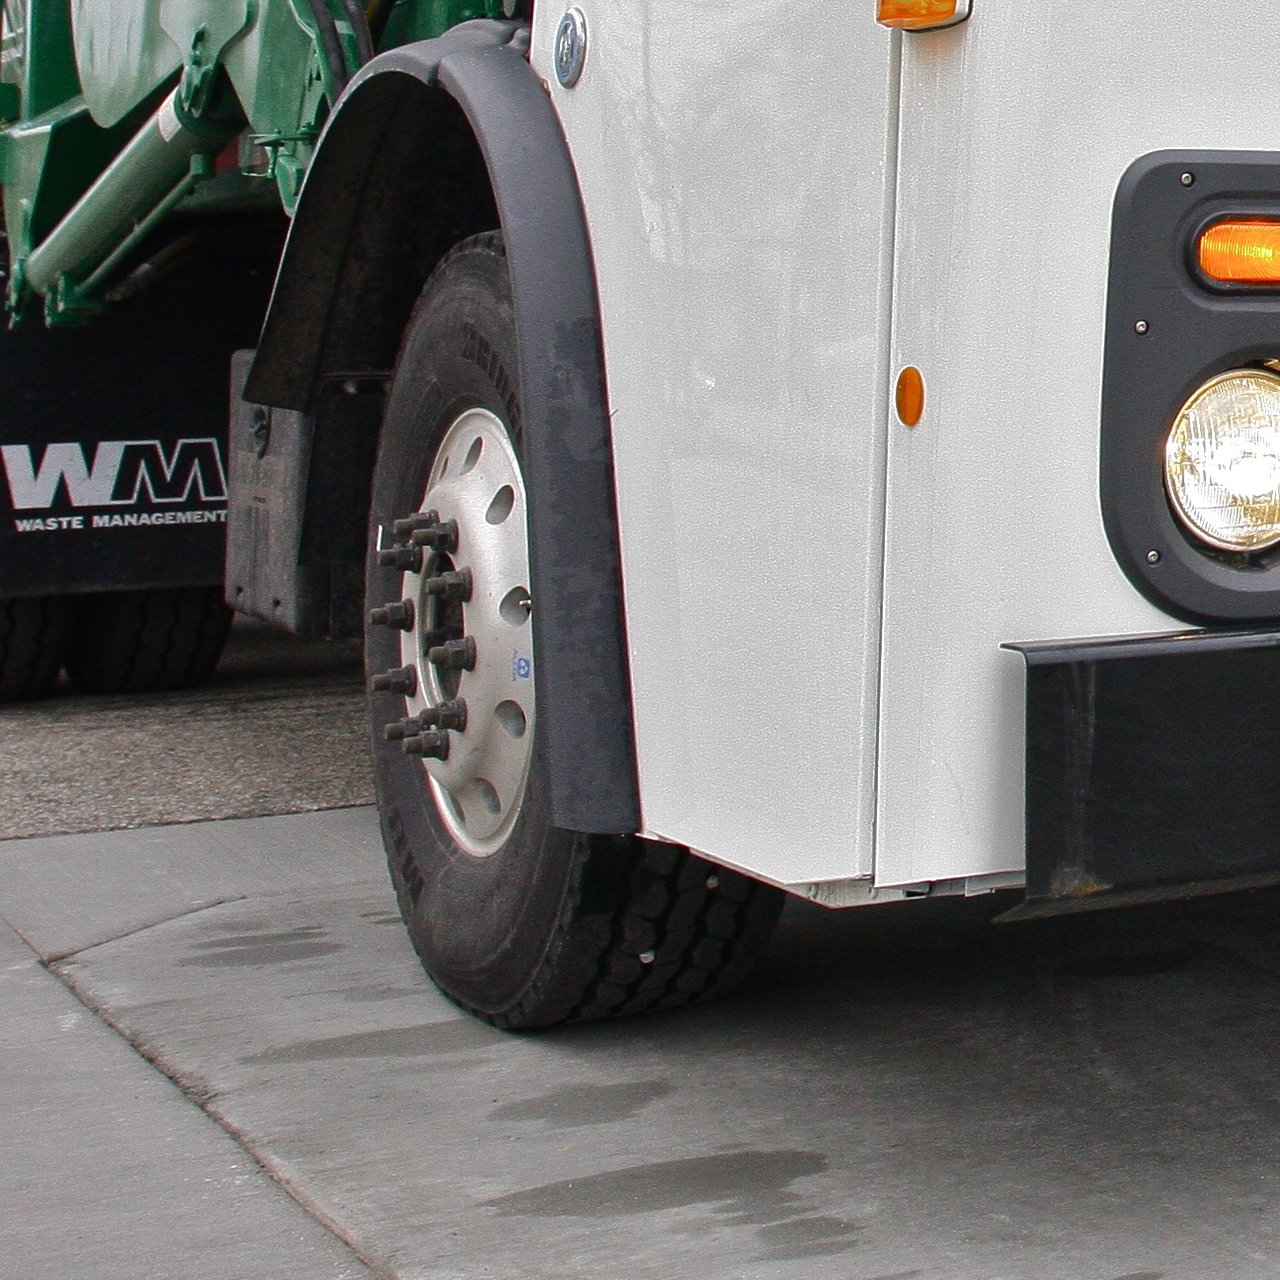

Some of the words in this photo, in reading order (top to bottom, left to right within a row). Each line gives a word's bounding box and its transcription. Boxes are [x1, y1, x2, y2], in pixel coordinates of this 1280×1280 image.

[1, 437, 229, 510] WM
[15, 516, 84, 532] WASTE
[92, 509, 228, 528] MANAGEMENT
